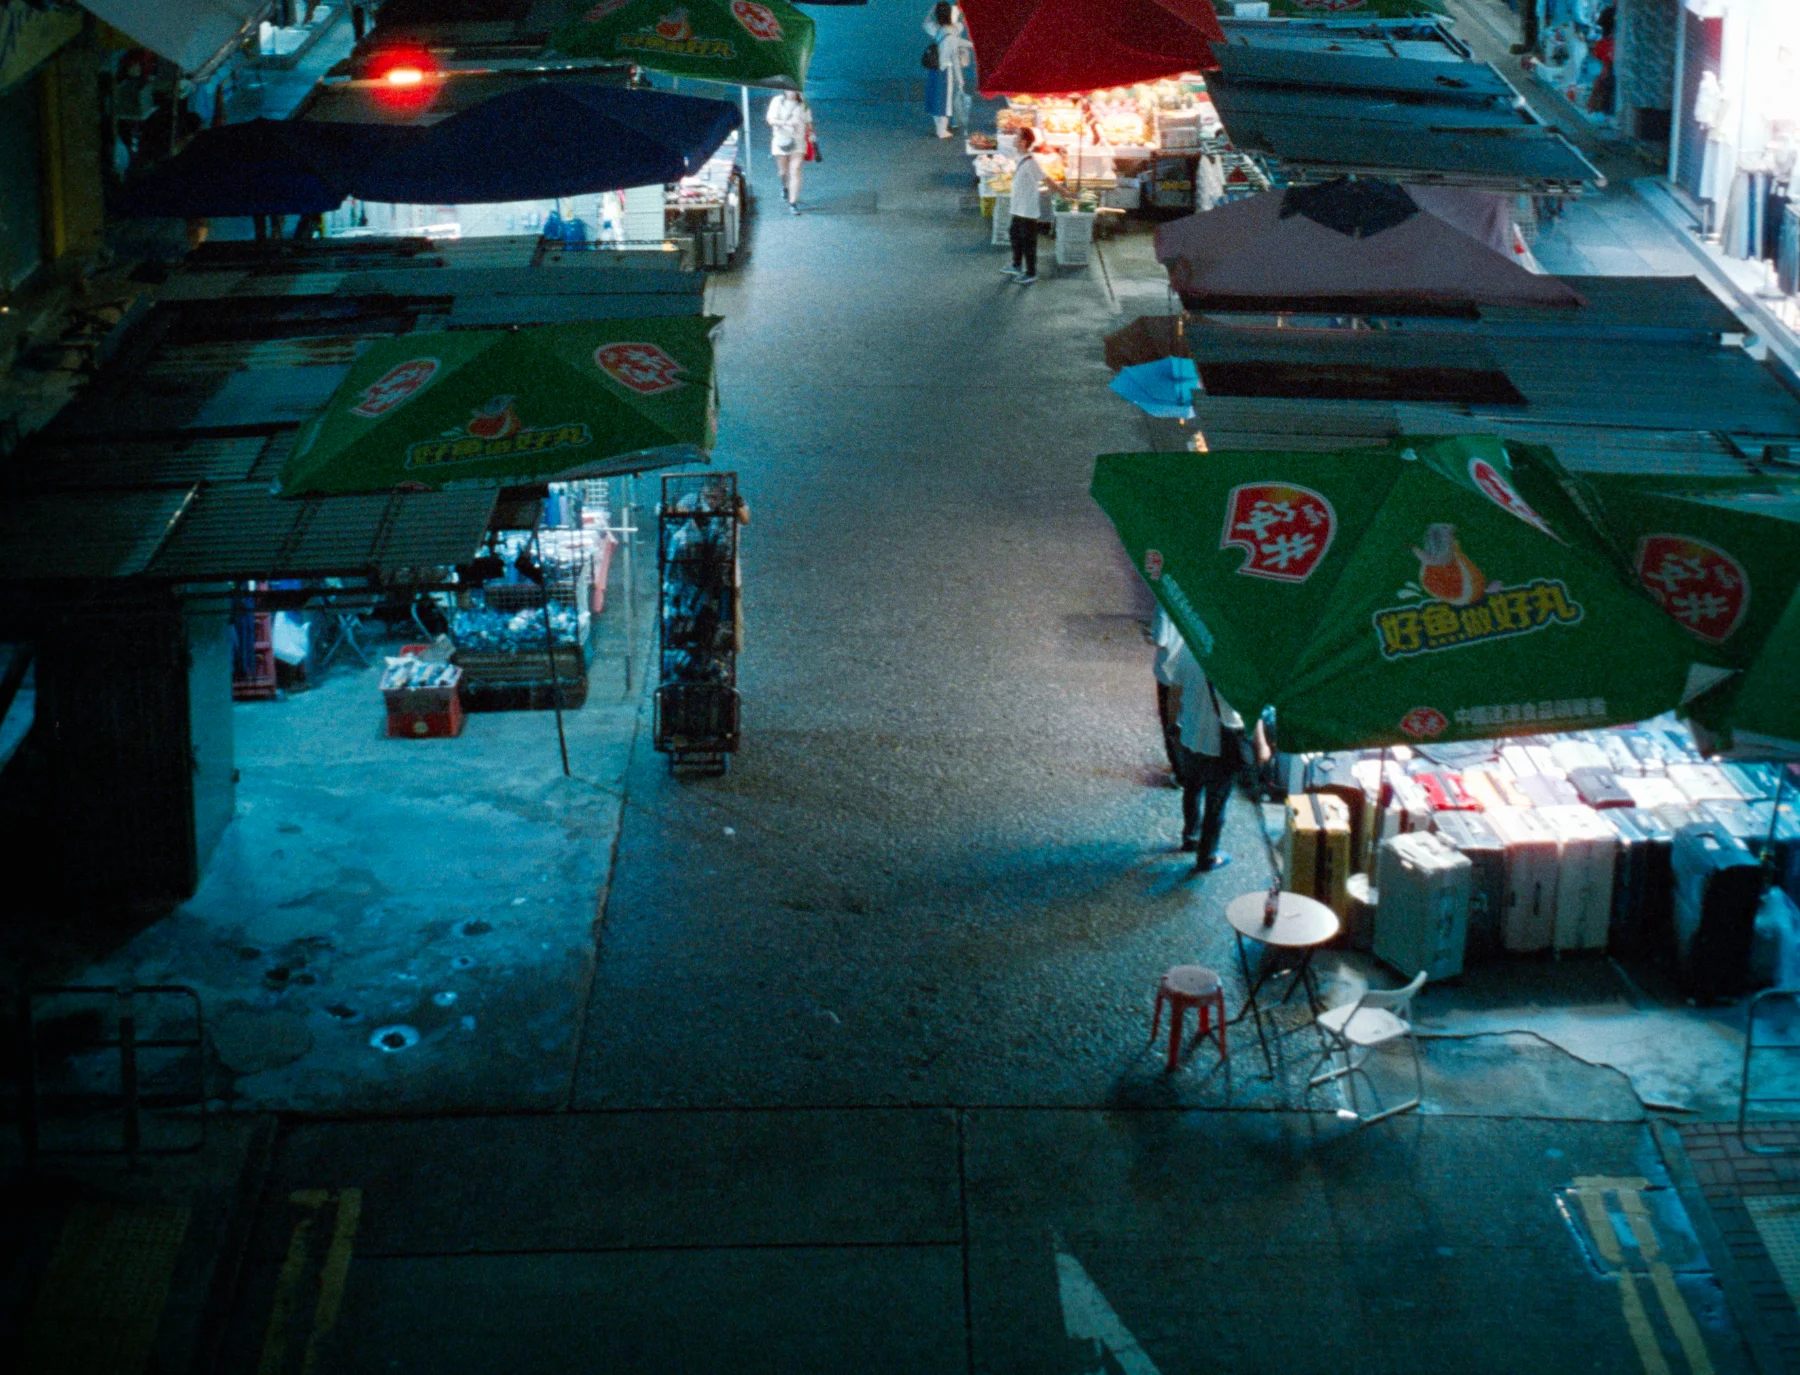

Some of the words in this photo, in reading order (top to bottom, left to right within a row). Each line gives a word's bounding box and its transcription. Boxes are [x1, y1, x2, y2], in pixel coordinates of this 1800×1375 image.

[1379, 583, 1578, 654] 好魚做好丸
